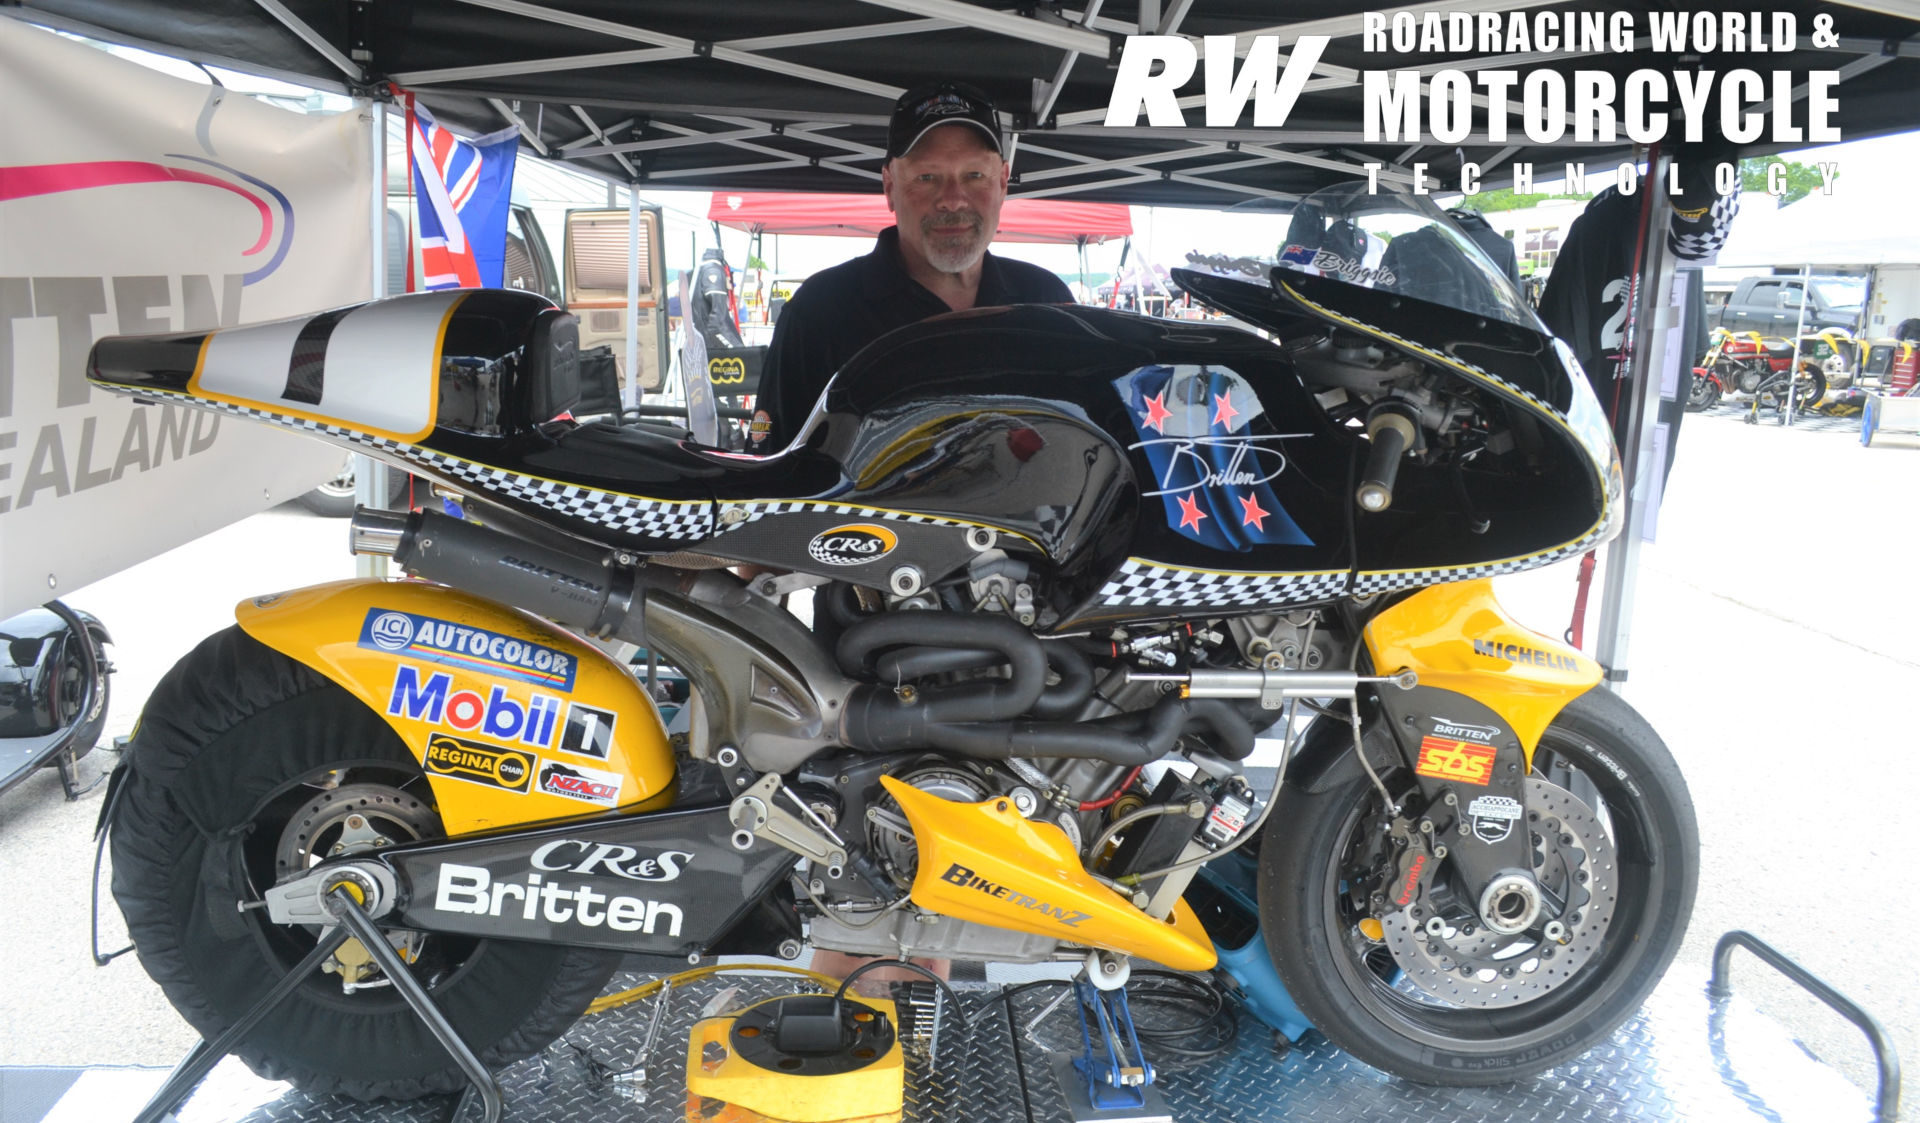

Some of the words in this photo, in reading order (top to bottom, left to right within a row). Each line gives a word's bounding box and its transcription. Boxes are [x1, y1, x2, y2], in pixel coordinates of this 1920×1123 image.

[1313, 250, 1396, 286] Briggsie
[1601, 279, 1630, 350] 2
[381, 617, 407, 635] ICI
[415, 621, 568, 676] AUTOCOLOR
[1474, 639, 1580, 673] MICHELIN
[387, 664, 561, 749] Mobil
[581, 713, 599, 751] 1
[1433, 724, 1492, 741] BRITTEN
[428, 746, 493, 772] REGINA
[500, 763, 525, 776] CHAIN
[547, 774, 618, 800] NZACU
[530, 839, 695, 882] CR&S
[1396, 855, 1425, 905] brembo
[434, 863, 684, 937] Britten
